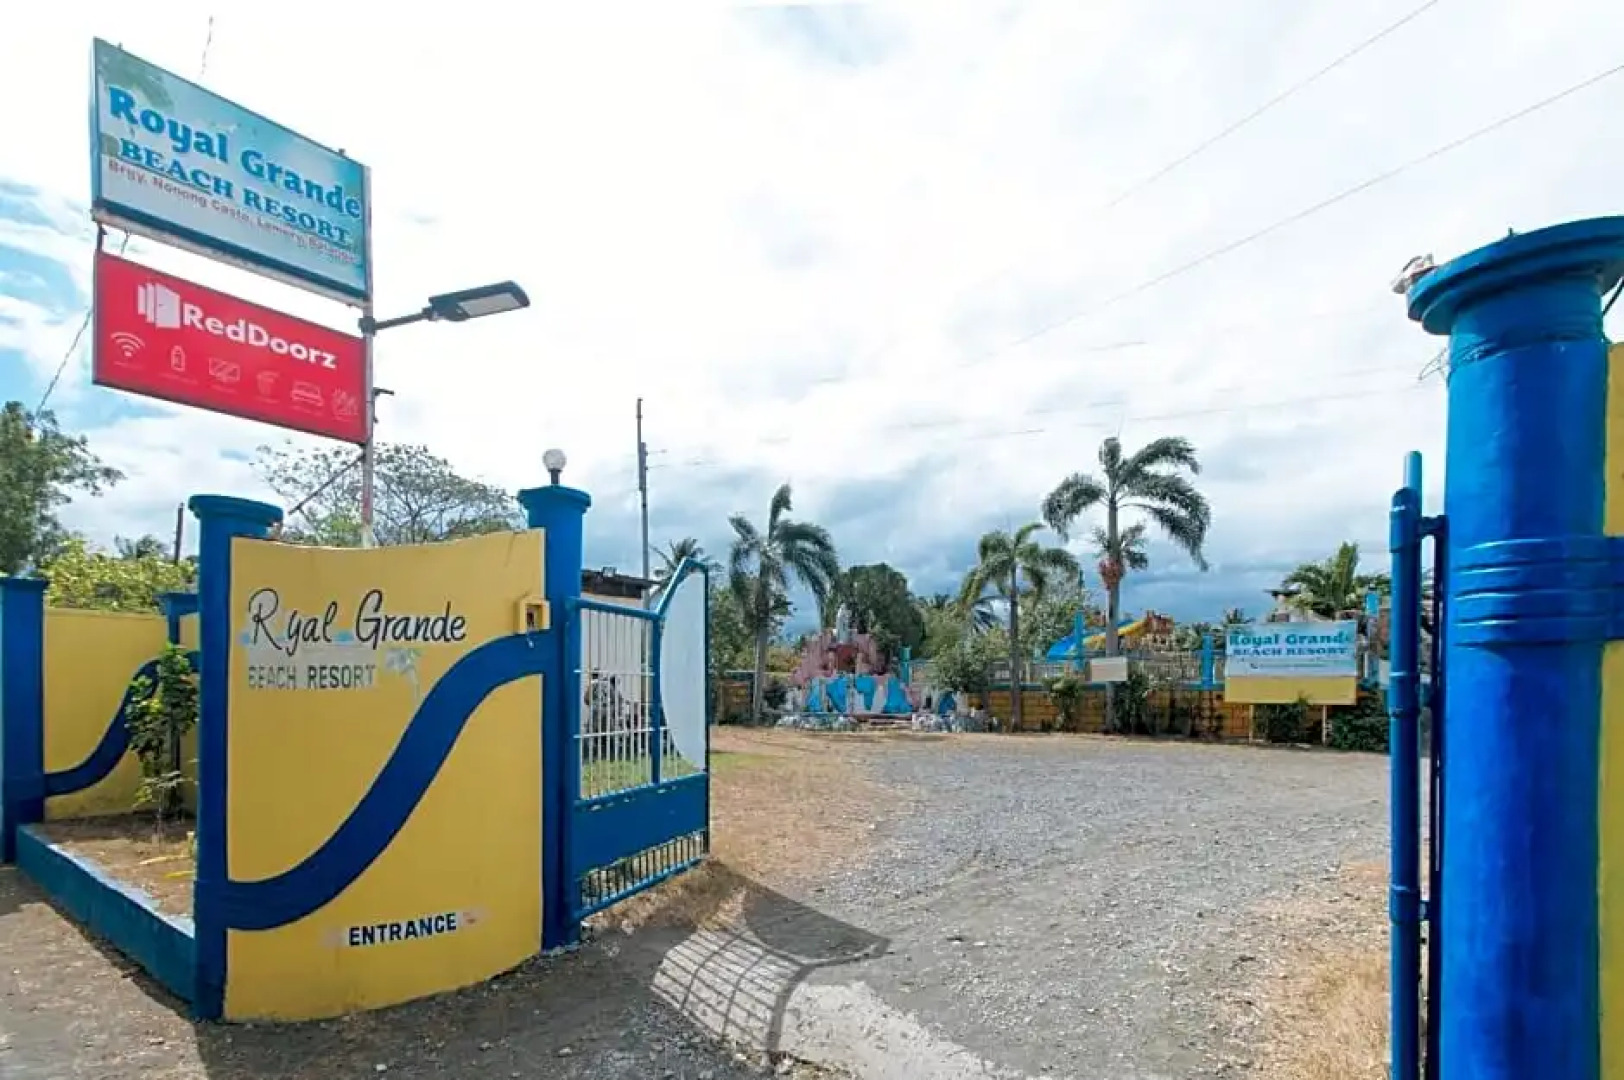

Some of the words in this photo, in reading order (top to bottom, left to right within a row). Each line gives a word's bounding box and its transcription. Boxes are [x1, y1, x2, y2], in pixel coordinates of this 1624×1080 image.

[107, 85, 229, 164] Royal
[239, 149, 361, 219] Grande
[119, 137, 234, 199] BEACH
[243, 188, 351, 245] RESORT
[182, 303, 338, 369] RedDoorz
[355, 588, 466, 650] Grande
[1229, 633, 1280, 648] Royal
[248, 665, 296, 690] BEACH
[306, 664, 376, 689] RESORT
[349, 911, 457, 946] ENTRANCE
